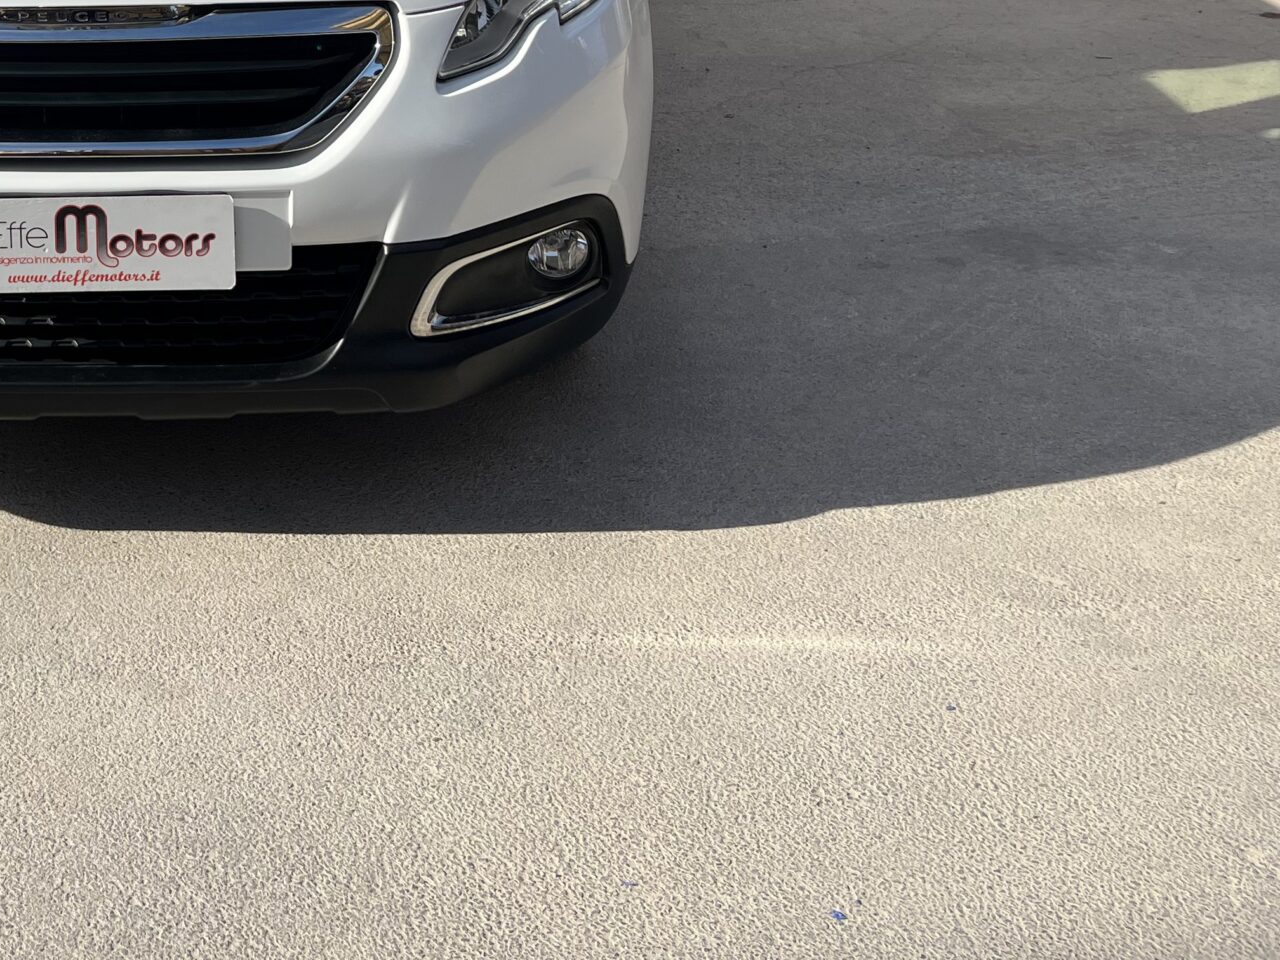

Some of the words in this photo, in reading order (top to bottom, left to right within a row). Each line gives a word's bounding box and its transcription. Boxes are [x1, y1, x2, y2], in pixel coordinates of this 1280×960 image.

[55, 204, 216, 267] Motors
[42, 254, 93, 265] movimento
[8, 269, 161, 286] www.dieffemotors.it
